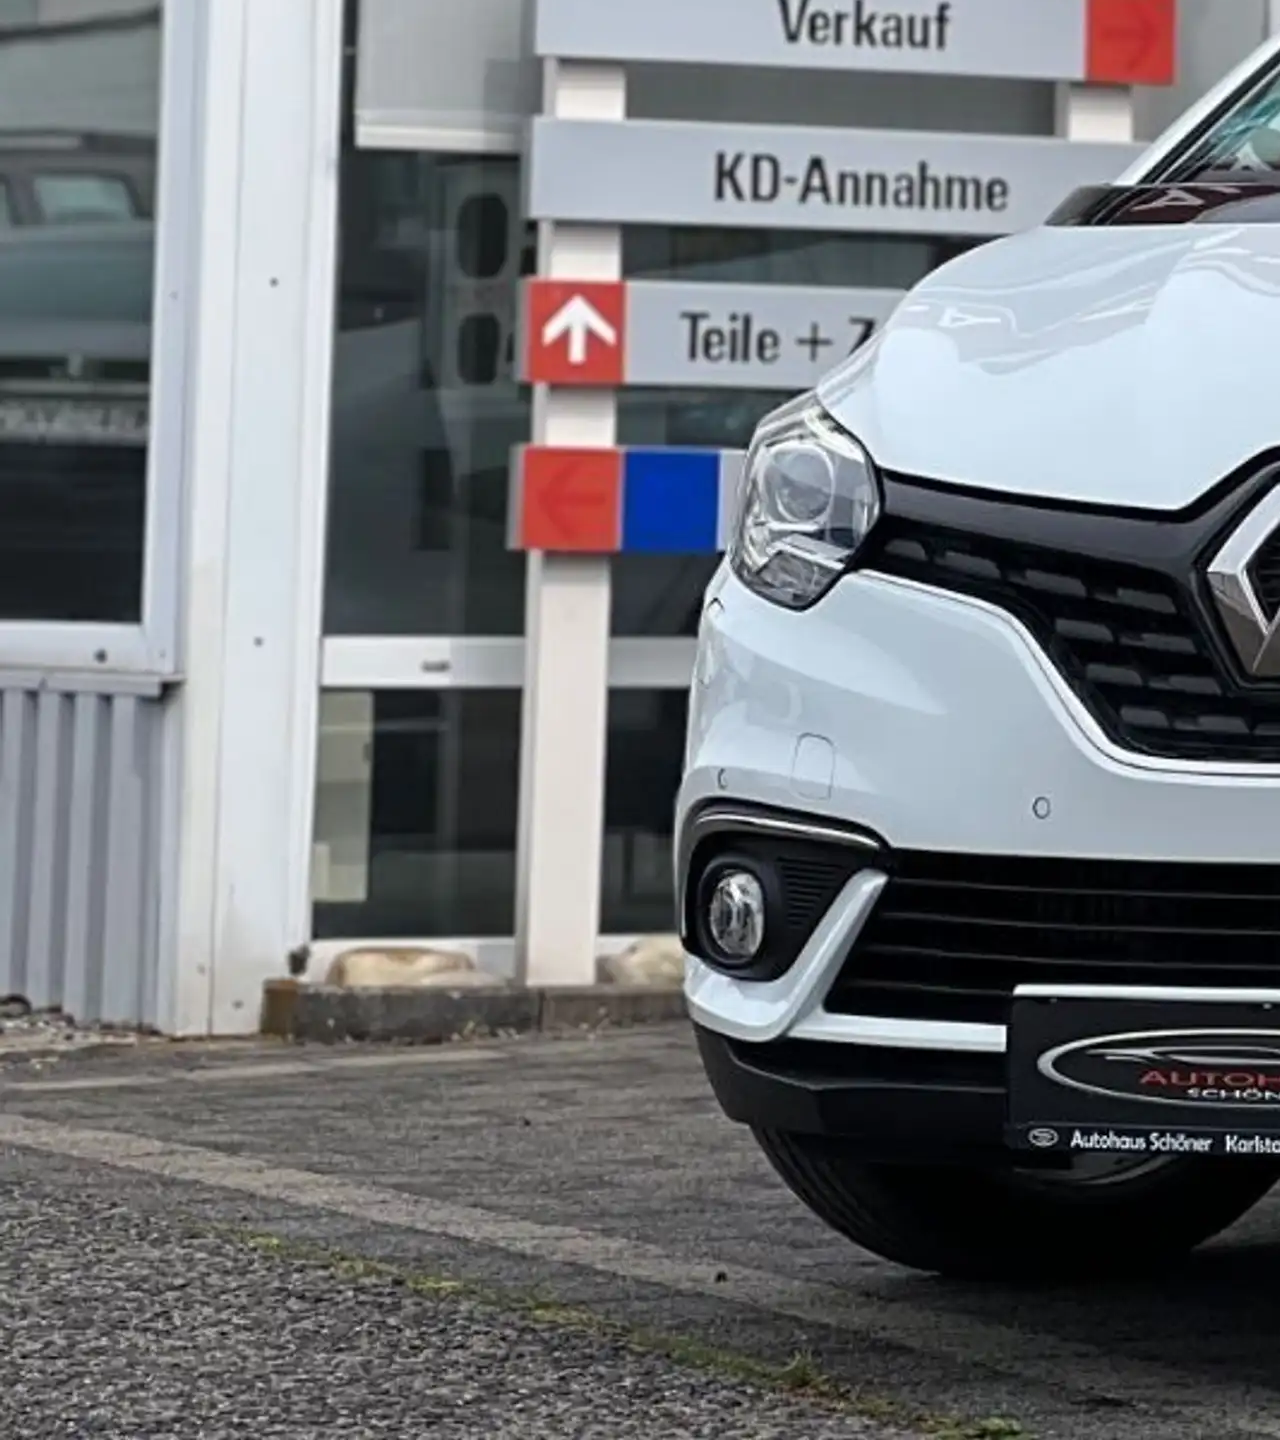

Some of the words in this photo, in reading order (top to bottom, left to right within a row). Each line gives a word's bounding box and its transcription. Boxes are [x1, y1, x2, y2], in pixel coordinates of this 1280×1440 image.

[715, 150, 1009, 214] KD-Annahme
[680, 311, 781, 364] Teile
[796, 321, 834, 362] +
[1070, 1128, 1146, 1150] Autohaus
[1149, 1131, 1214, 1152] Schöner
